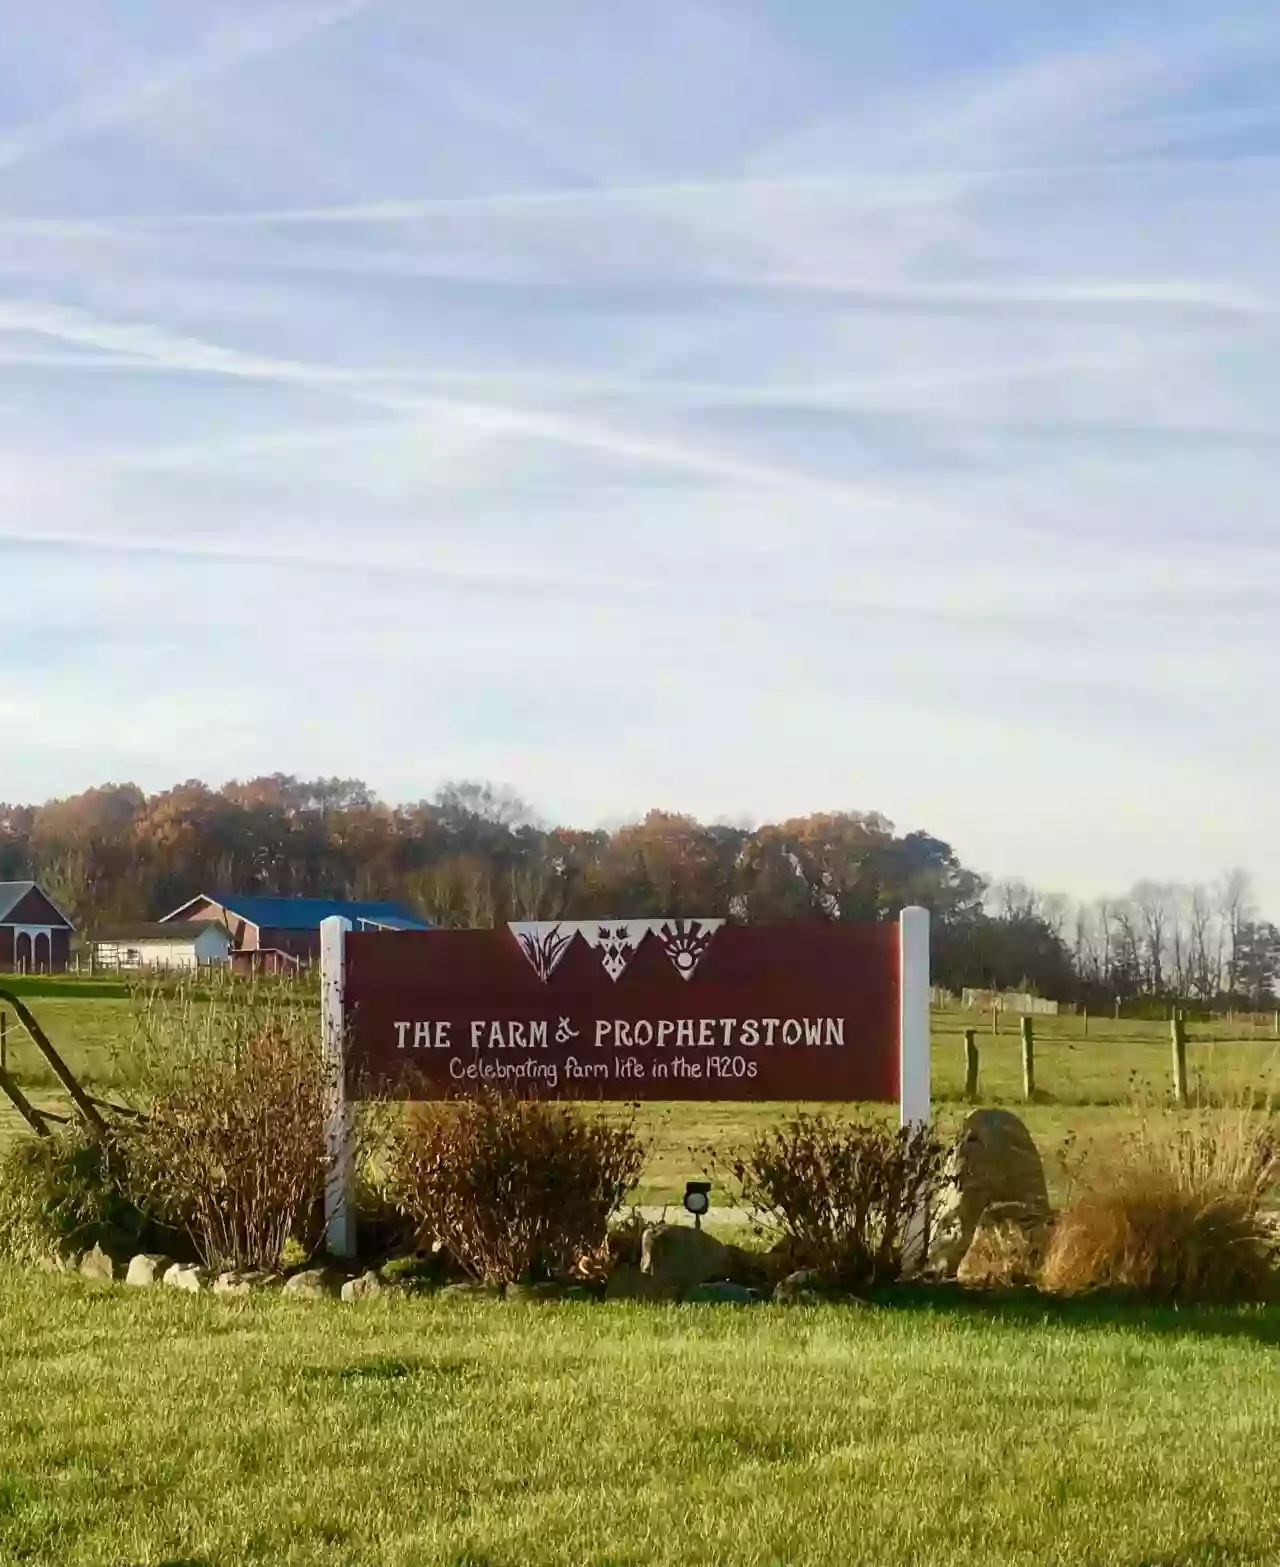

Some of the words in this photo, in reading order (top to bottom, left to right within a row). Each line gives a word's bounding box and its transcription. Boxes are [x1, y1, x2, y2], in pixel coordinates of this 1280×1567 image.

[393, 1021, 452, 1049] THE
[470, 1020, 548, 1049] FARM
[594, 1018, 845, 1047] PROPHETSTOWN
[449, 1056, 558, 1089] Celebrating
[564, 1056, 609, 1078] farm
[614, 1056, 645, 1078] life
[652, 1058, 668, 1078] in
[670, 1056, 702, 1078] the
[706, 1055, 758, 1078] 1920s
